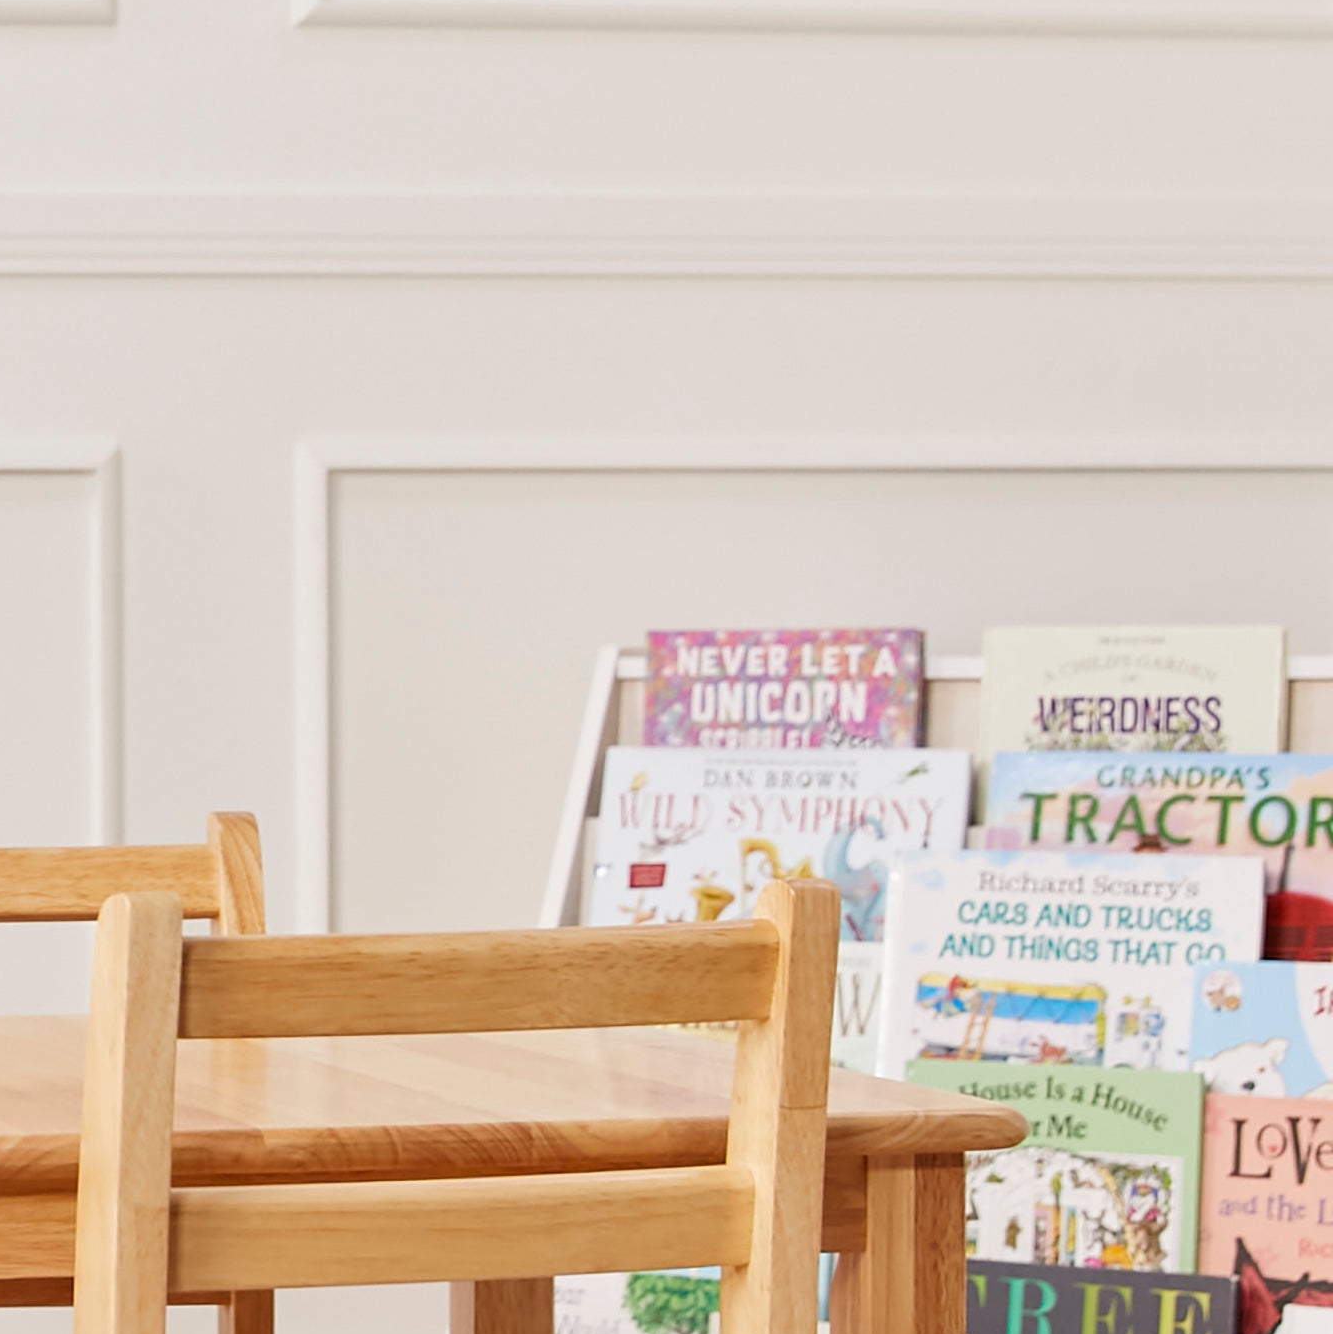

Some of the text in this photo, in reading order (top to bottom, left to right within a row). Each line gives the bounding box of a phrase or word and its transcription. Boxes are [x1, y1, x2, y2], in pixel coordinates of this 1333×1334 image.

[677, 643, 898, 677] NEVER LET A
[690, 679, 868, 724] UNICORN
[1038, 695, 1221, 735] WEIRDNESS
[703, 769, 859, 791] DAN BROWN
[1097, 764, 1271, 791] GRANDPA'S
[619, 792, 944, 836] WILD SYMPHONY
[1020, 793, 1333, 848] TRACTOR
[978, 871, 1200, 902] Richard Scarry's
[957, 900, 1213, 933] CARS AND TRUCKS
[939, 932, 994, 959] AND
[1108, 938, 1176, 965] THAT
[1046, 1075, 1066, 1100] Is
[1071, 1085, 1085, 1101] a
[1091, 1082, 1168, 1133] House
[1046, 1114, 1088, 1139] Me
[1219, 1195, 1258, 1217] and
[1266, 1194, 1306, 1223] the
